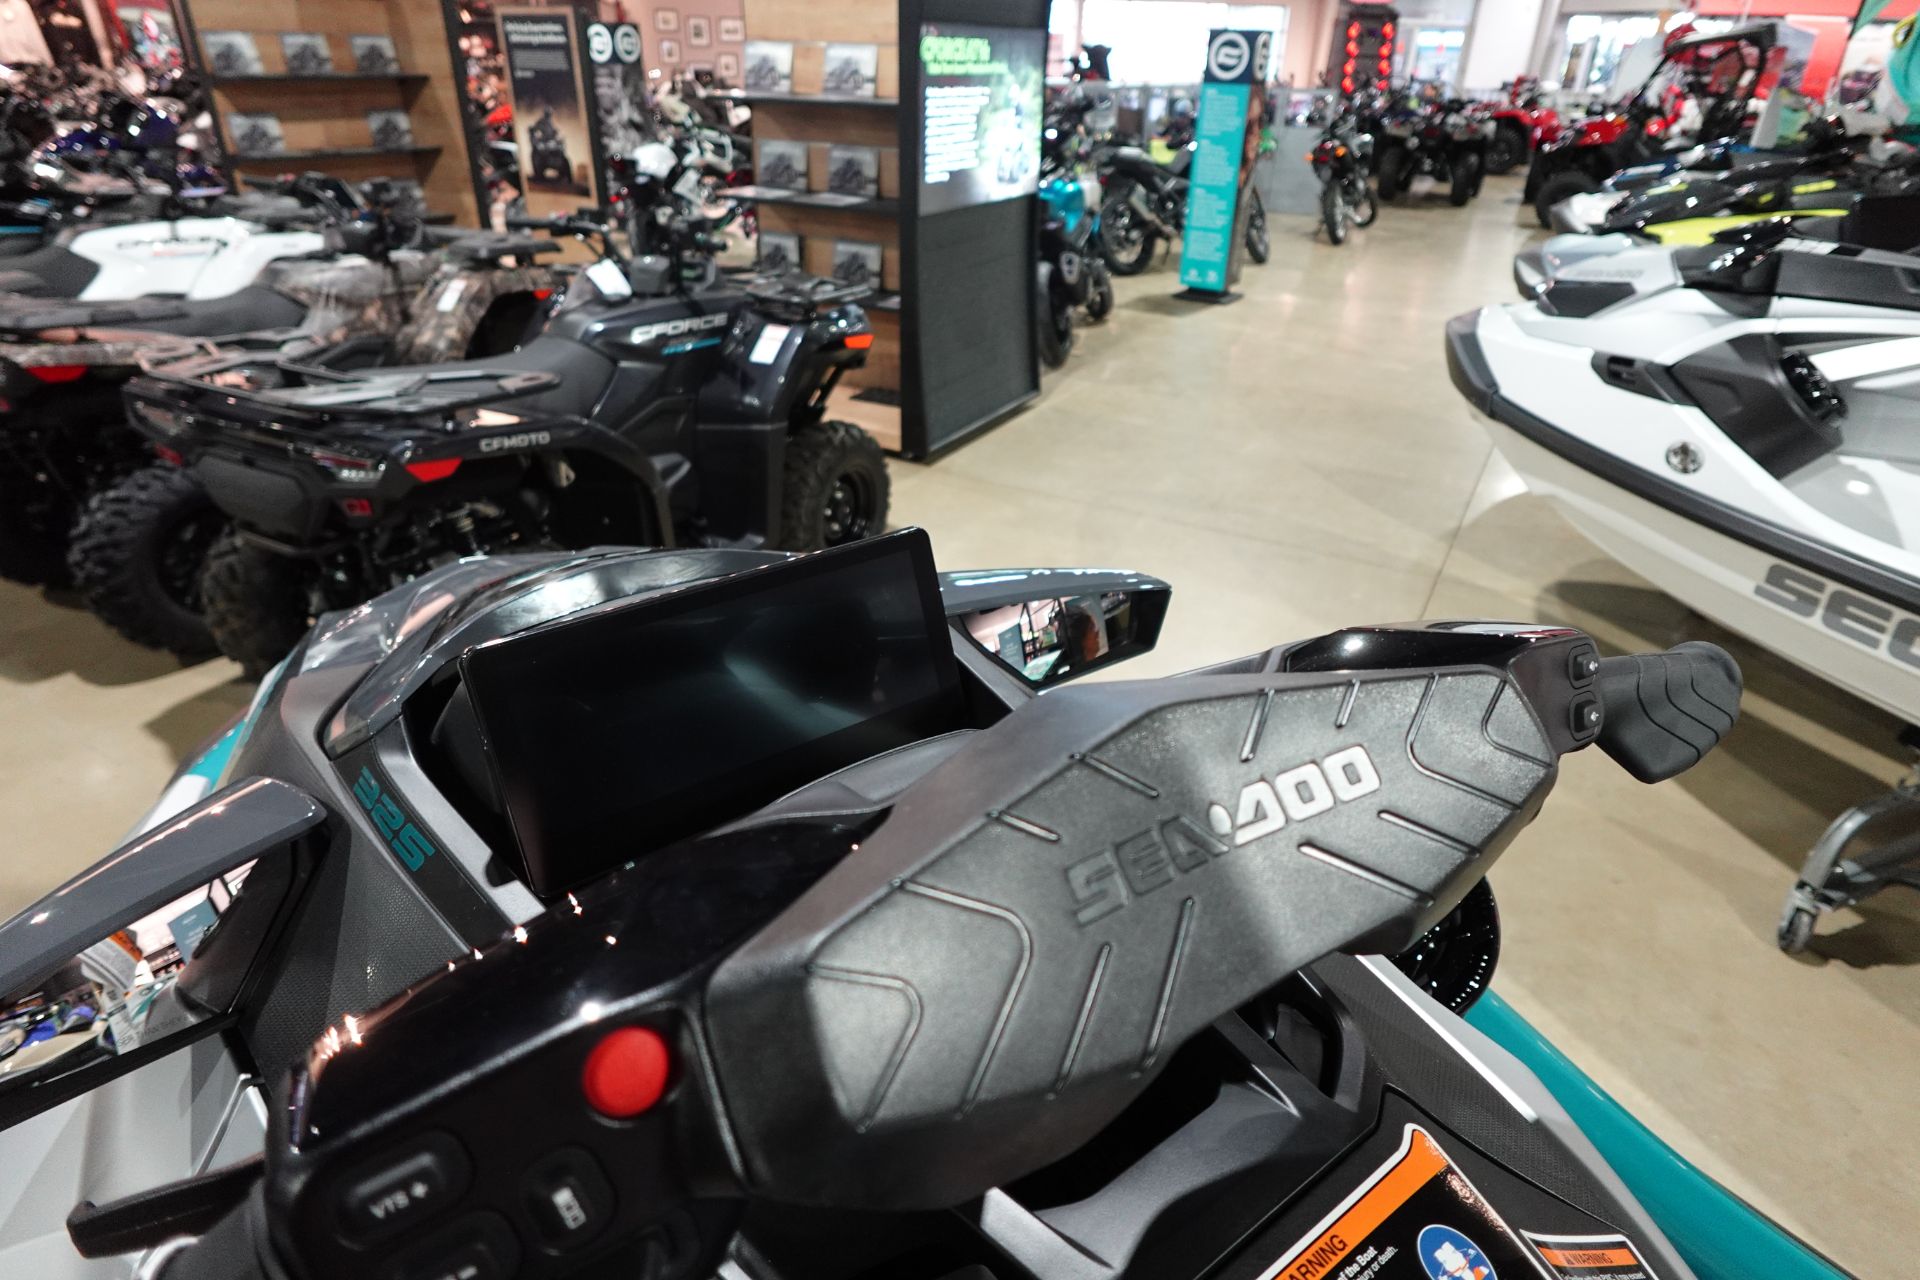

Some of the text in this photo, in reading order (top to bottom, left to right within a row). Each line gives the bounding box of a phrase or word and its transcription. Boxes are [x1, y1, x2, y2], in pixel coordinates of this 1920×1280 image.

[630, 312, 728, 344] CFORCE
[479, 430, 551, 453] CFMOTO
[353, 766, 436, 872] 325
[1344, 1262, 1361, 1278] the
[1356, 1245, 1378, 1266] Boat
[1370, 1261, 1380, 1272] or
[1378, 1246, 1399, 1265] death.
